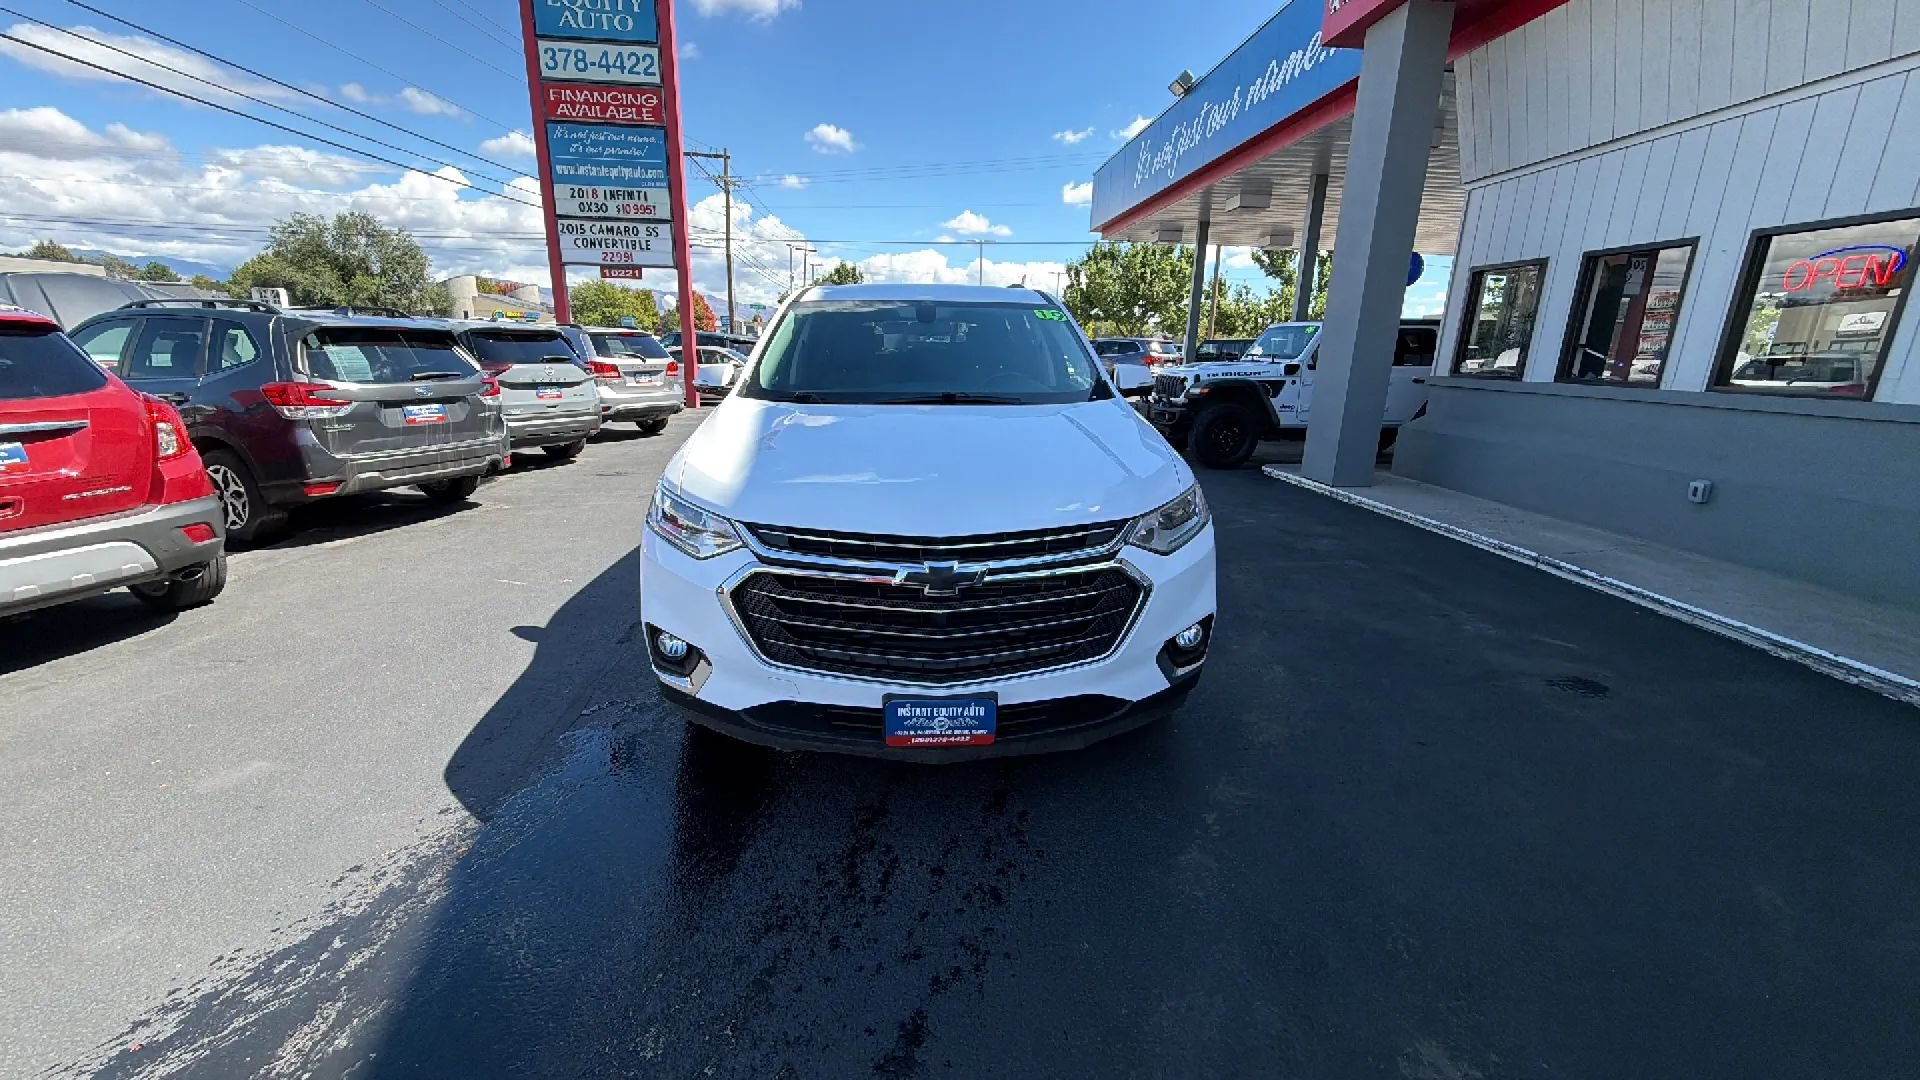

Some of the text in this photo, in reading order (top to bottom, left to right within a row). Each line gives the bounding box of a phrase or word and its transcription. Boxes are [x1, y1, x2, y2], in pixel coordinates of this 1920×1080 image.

[559, 10, 634, 32] AUTO
[543, 47, 657, 77] 378-4422
[549, 88, 659, 107] FINANCING
[556, 104, 656, 121] AVAILABLE
[555, 163, 665, 181] www.instantequityauto.com
[569, 187, 649, 202] 2018 INFINITI
[559, 223, 660, 238] 2015 CAMARO SS
[573, 237, 652, 250] CONVERTIBLE
[602, 269, 641, 278] 10221
[1783, 251, 1901, 293] OPEN
[897, 706, 985, 717] INSTANT EQUITY AUTO
